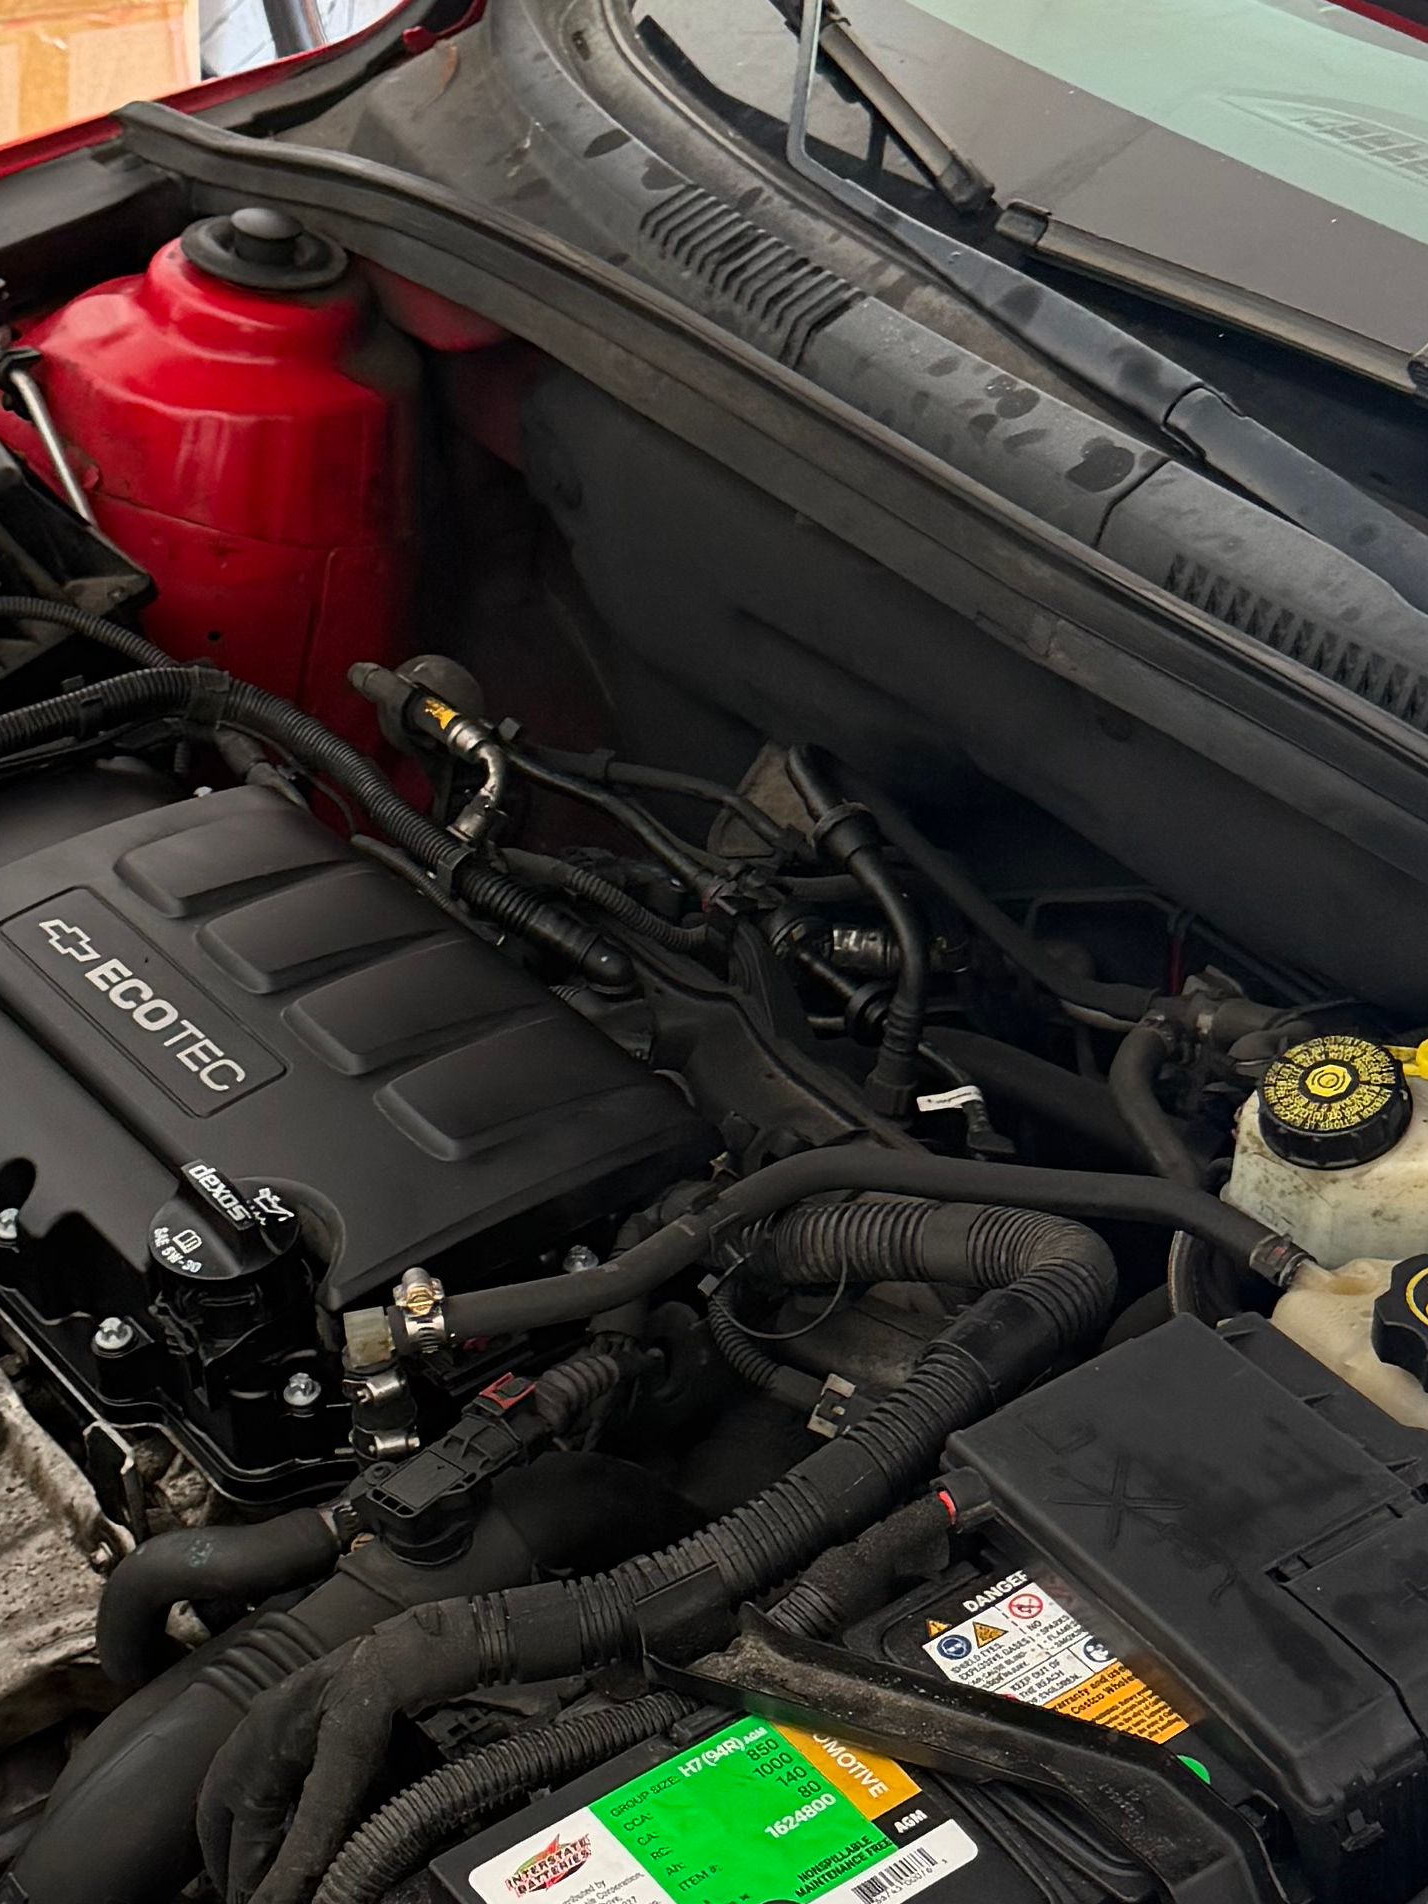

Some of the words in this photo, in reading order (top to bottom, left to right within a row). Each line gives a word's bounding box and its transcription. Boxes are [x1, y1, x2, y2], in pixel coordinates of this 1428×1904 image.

[85, 958, 246, 1092] ECOTEC
[189, 1163, 253, 1223] dexos
[153, 1226, 172, 1261] SAE
[164, 1244, 204, 1273] 5W-30
[1068, 1690, 1106, 1716] Costco
[608, 1789, 651, 1819] GROUP
[741, 1724, 769, 1747] AGM
[622, 1809, 654, 1834] CCA:
[745, 1735, 781, 1764] 850
[636, 1828, 660, 1848] CA:
[751, 1749, 795, 1782] 1000
[796, 1777, 823, 1801] 80
[649, 1842, 674, 1862] RC:
[774, 1763, 809, 1790] 140
[677, 1867, 711, 1893] ITEM
[762, 1789, 840, 1843] 1624800
[892, 1805, 929, 1835] AGM
[503, 1832, 593, 1890] INTERSTATE
[513, 1845, 595, 1898] BATTERIES
[593, 1877, 607, 1891] by
[792, 1850, 869, 1900] MAINTENANCE
[864, 1834, 894, 1858] FREE
[796, 1834, 874, 1884] NONSPILLABLE
